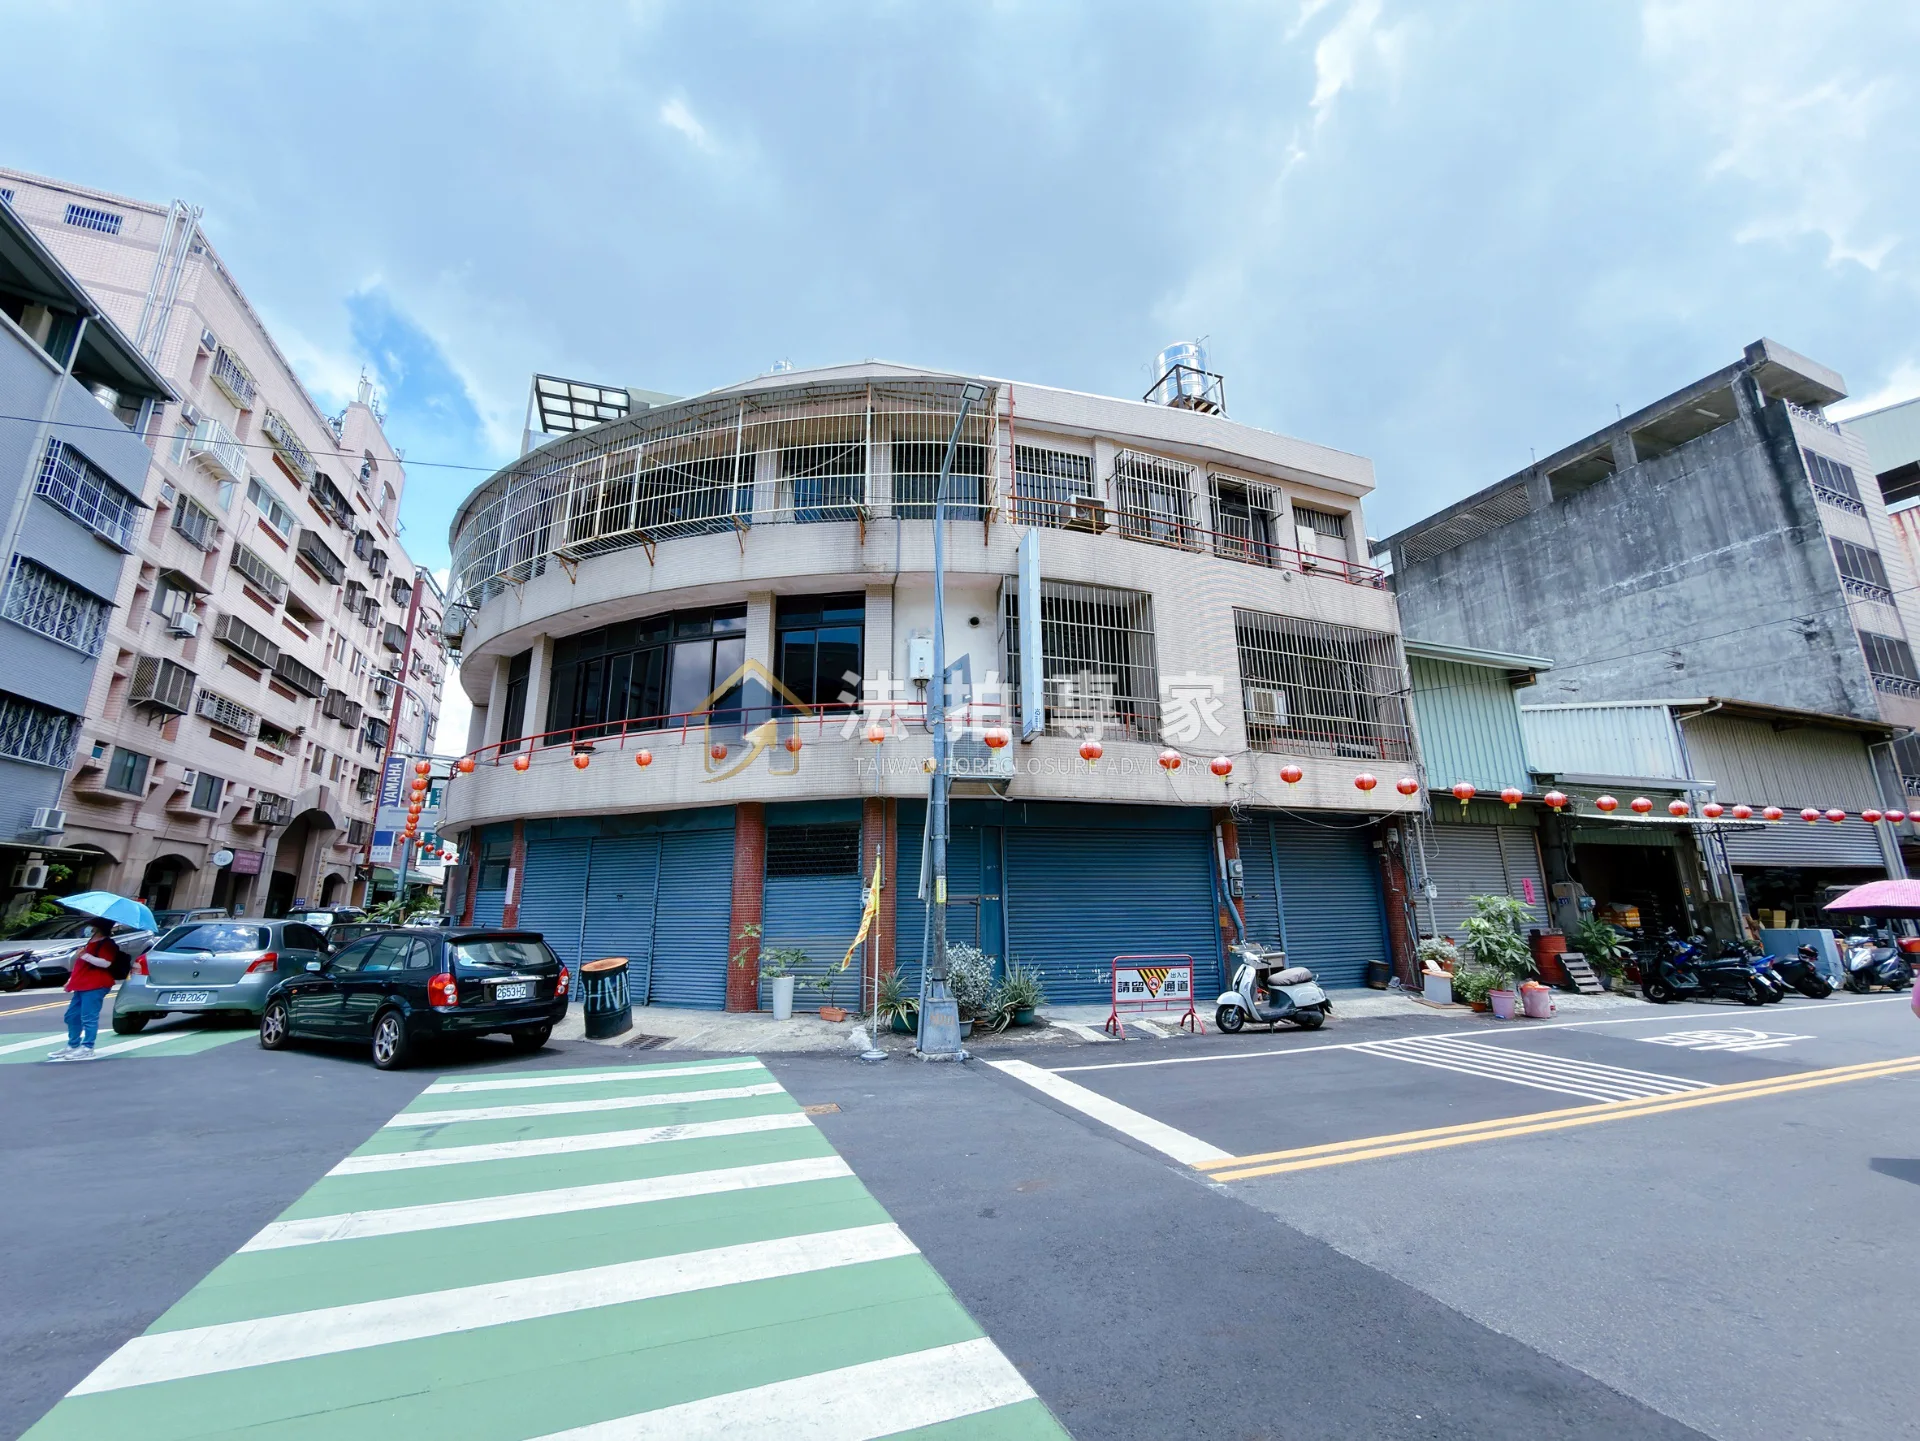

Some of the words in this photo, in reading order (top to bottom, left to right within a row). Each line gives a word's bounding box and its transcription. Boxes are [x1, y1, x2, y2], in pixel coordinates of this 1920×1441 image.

[382, 762, 403, 804] YAMAHA
[1117, 981, 1144, 993] 請留
[1164, 980, 1189, 992] 通道
